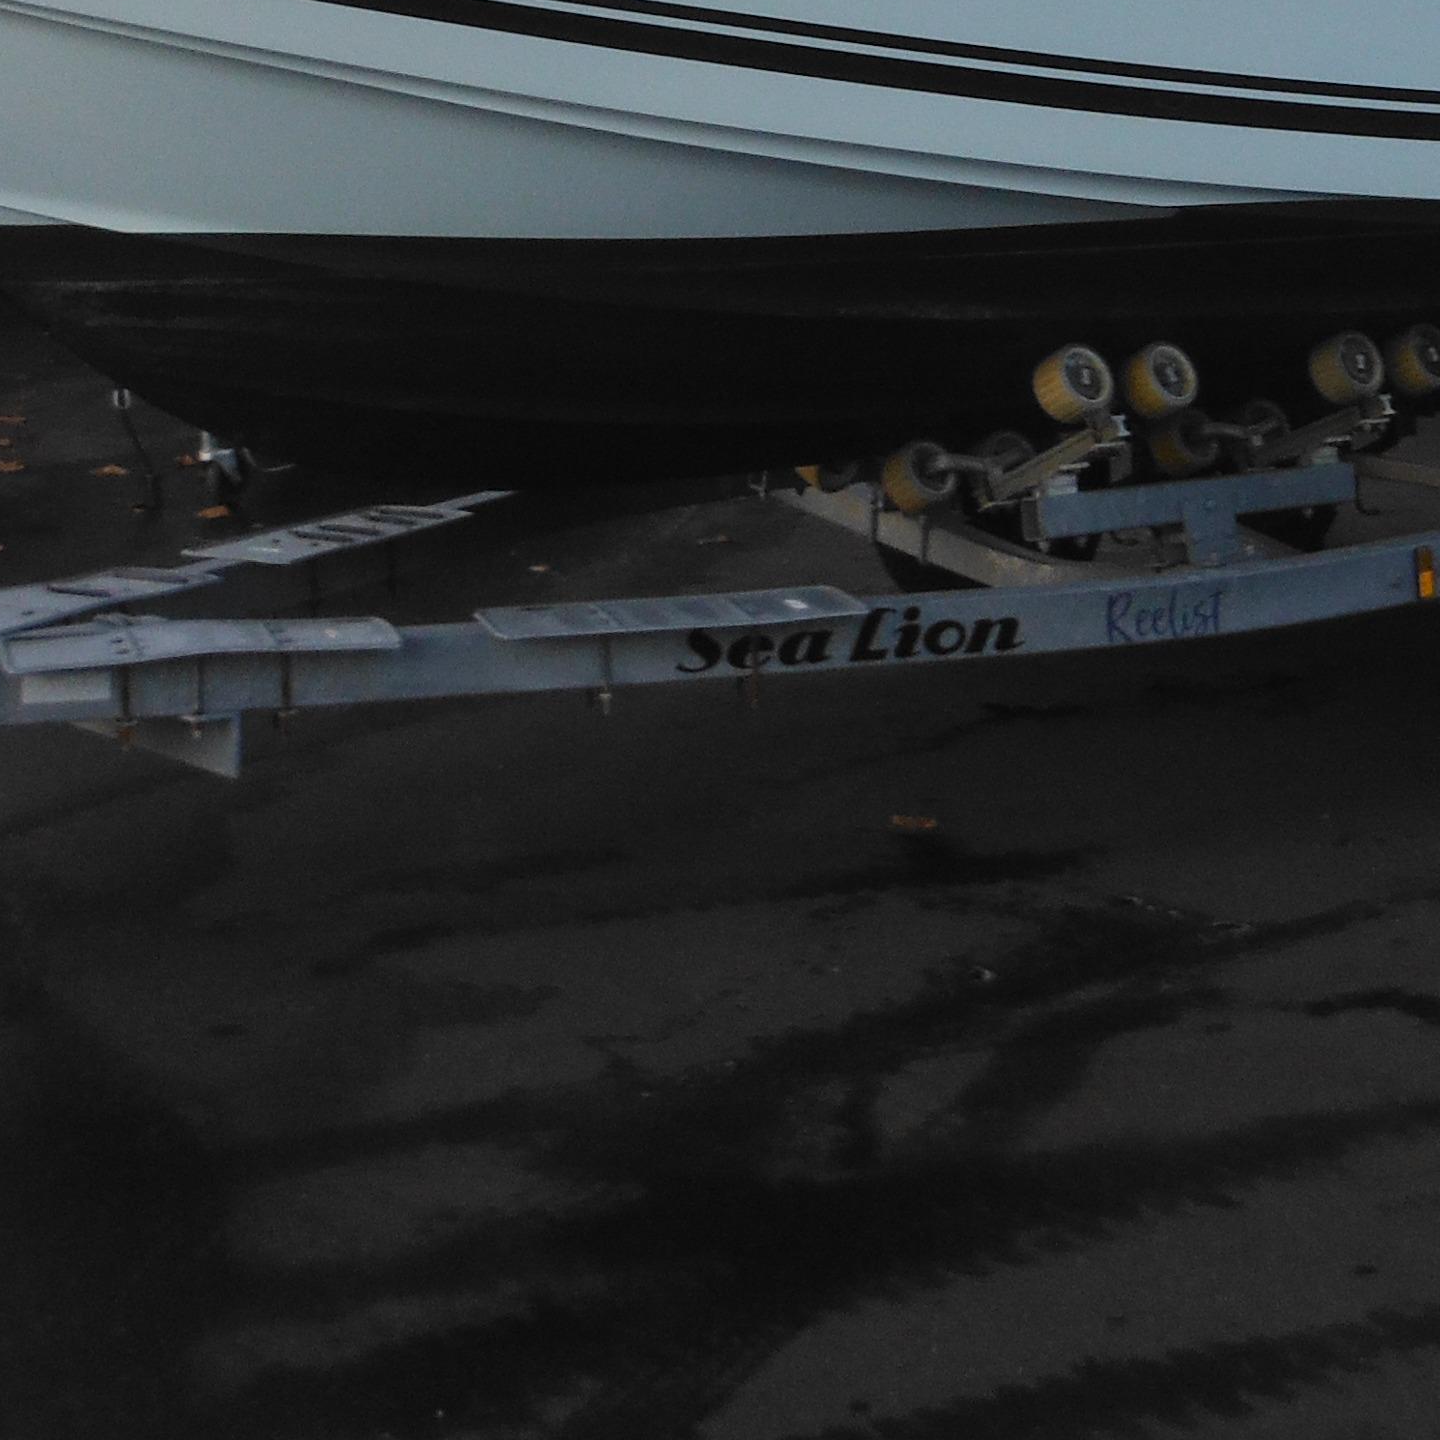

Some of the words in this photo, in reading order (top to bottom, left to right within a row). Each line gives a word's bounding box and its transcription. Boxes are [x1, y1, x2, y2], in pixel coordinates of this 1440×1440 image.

[676, 627, 833, 672] Sea
[850, 607, 1025, 661] Lion
[1105, 590, 1224, 642] Reelist
